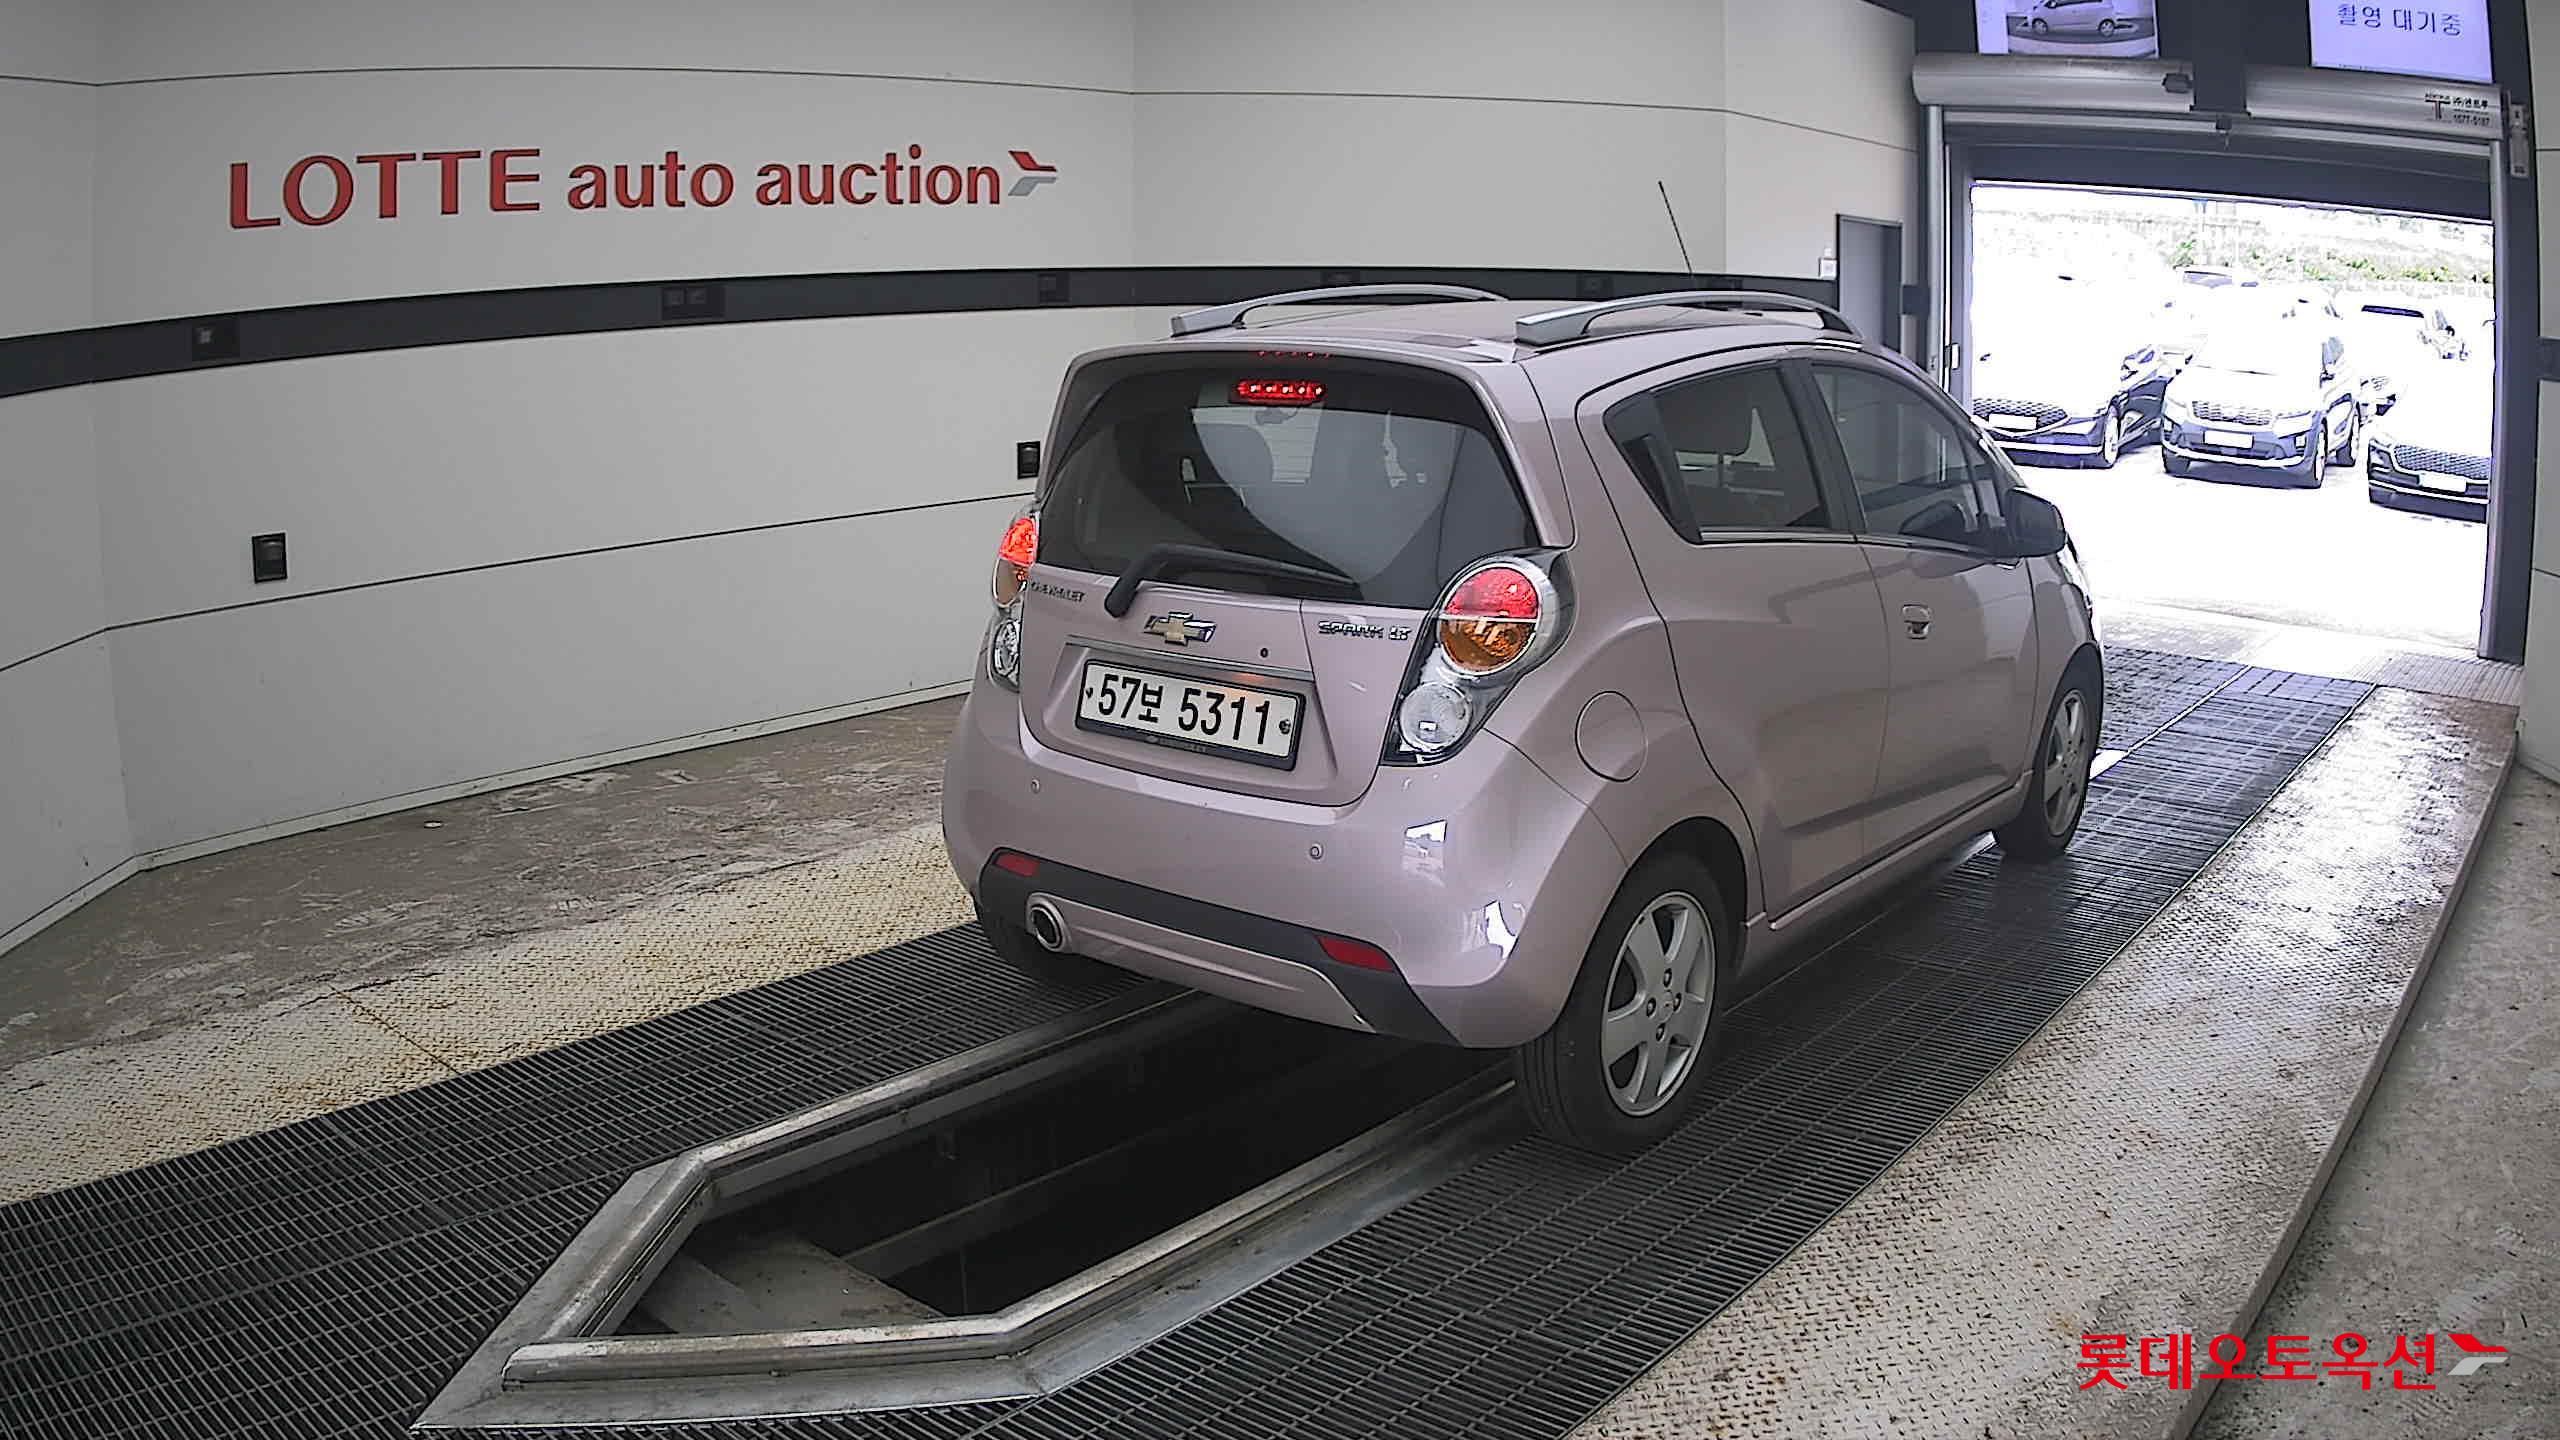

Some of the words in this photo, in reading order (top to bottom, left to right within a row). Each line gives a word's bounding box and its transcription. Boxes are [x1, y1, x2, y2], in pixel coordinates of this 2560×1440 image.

[2337, 4, 2382, 28] 촬영
[2393, 8, 2461, 36] 대기중
[230, 148, 540, 229] LOTTE
[567, 150, 734, 210] auto
[755, 143, 1000, 206] auction
[1098, 673, 1164, 724] 57보
[1177, 687, 1271, 745] 5311
